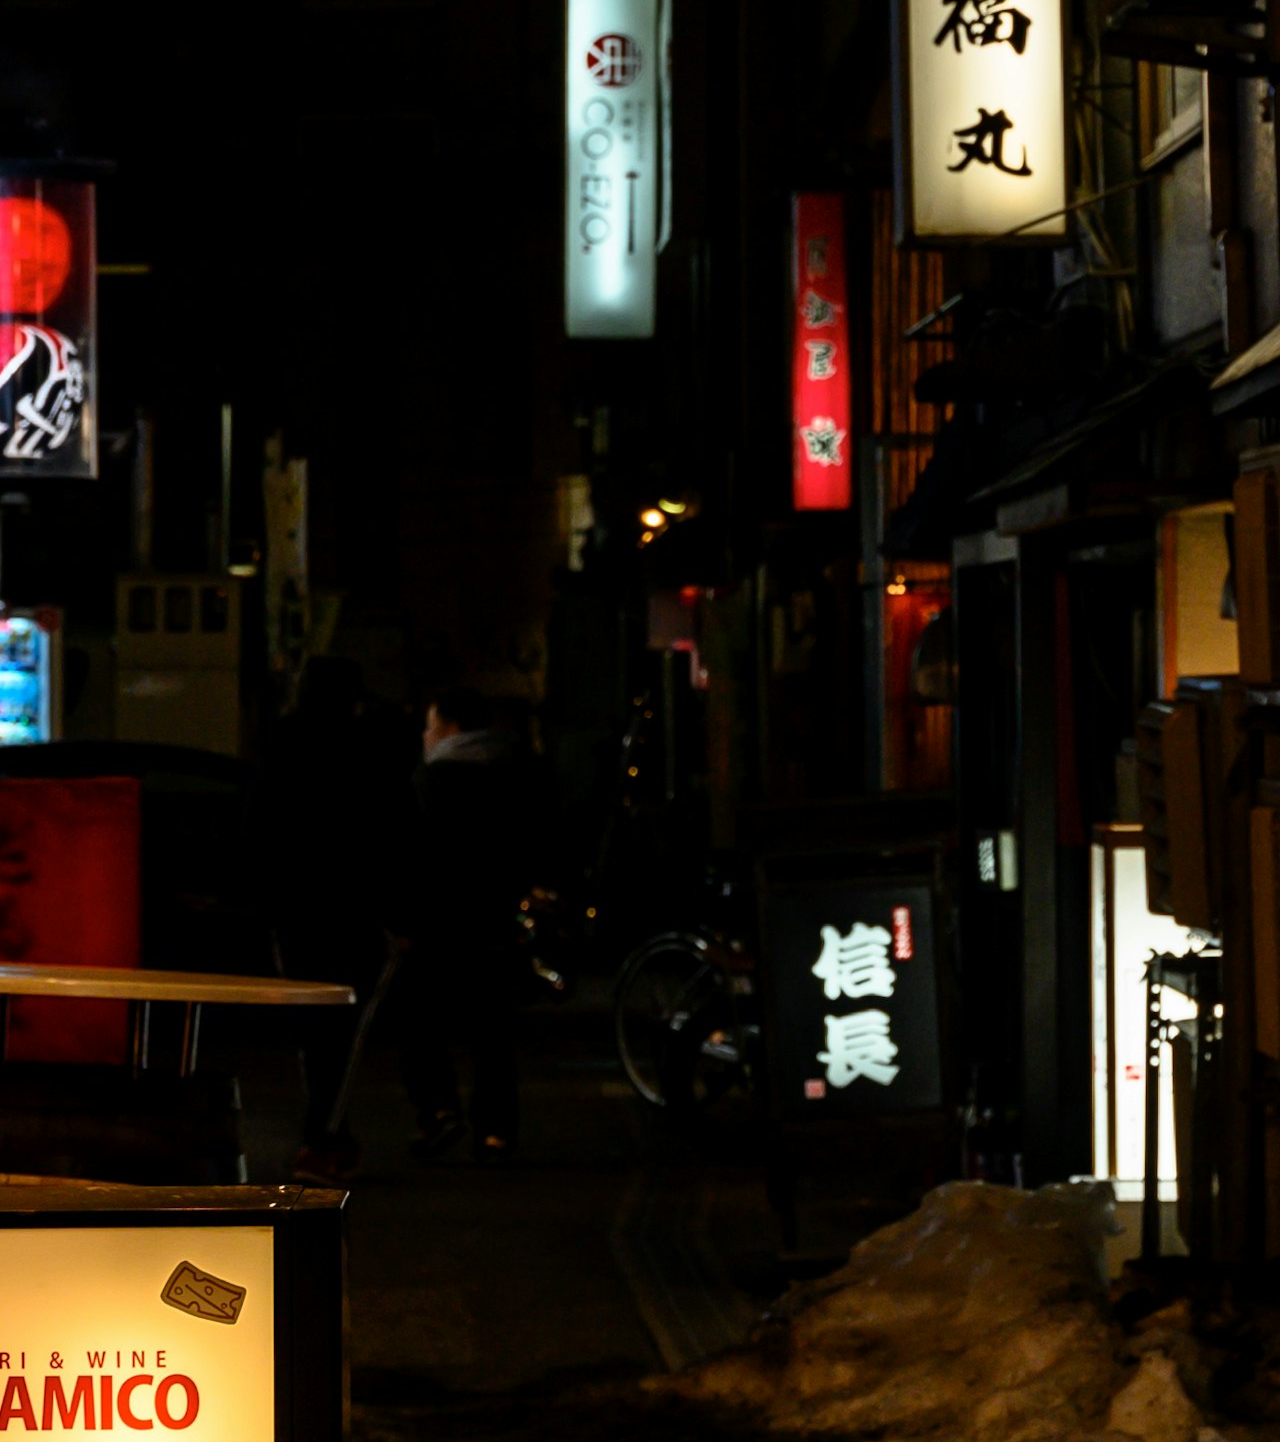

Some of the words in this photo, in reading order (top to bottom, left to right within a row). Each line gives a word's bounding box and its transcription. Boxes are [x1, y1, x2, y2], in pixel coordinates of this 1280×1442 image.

[811, 921, 901, 1090] 信長
[49, 1351, 66, 1370] &
[86, 1350, 170, 1370] WINE
